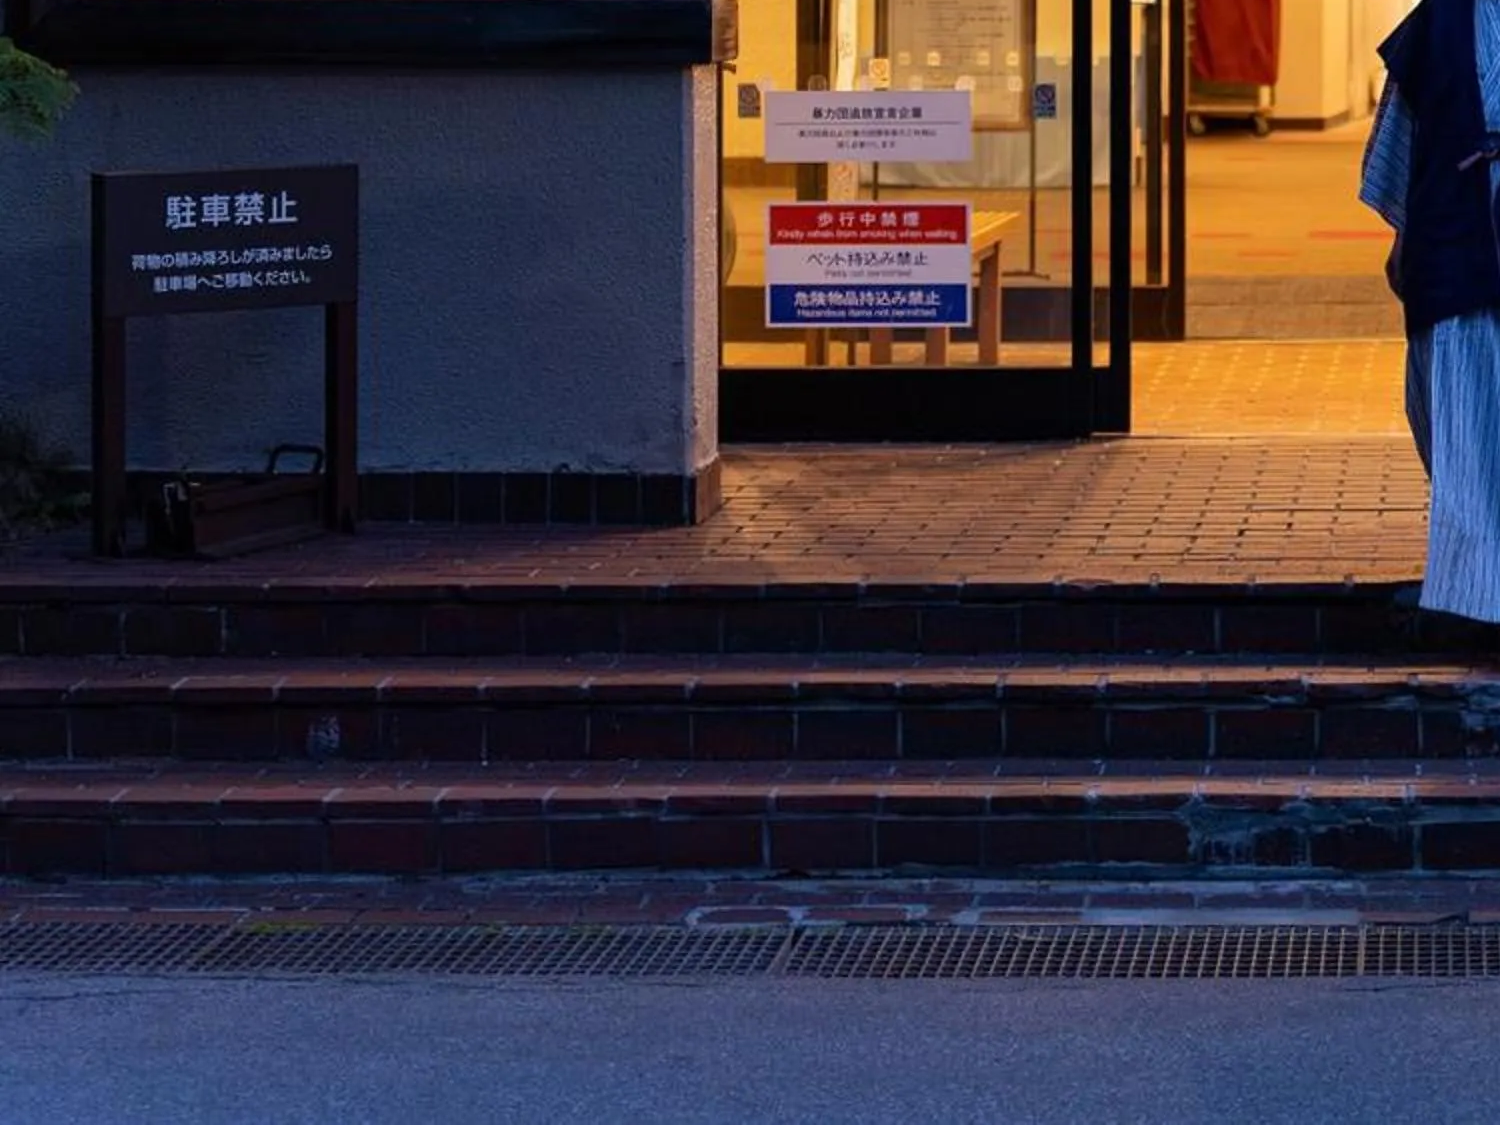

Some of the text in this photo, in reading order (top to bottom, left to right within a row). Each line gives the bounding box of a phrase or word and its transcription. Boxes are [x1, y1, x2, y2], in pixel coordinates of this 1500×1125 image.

[165, 191, 299, 229] 駐車禁止
[817, 211, 921, 227] 歩行中禁煙
[807, 251, 929, 267] ペット持込み禁止
[794, 290, 942, 306] 危険物品持込み禁止
